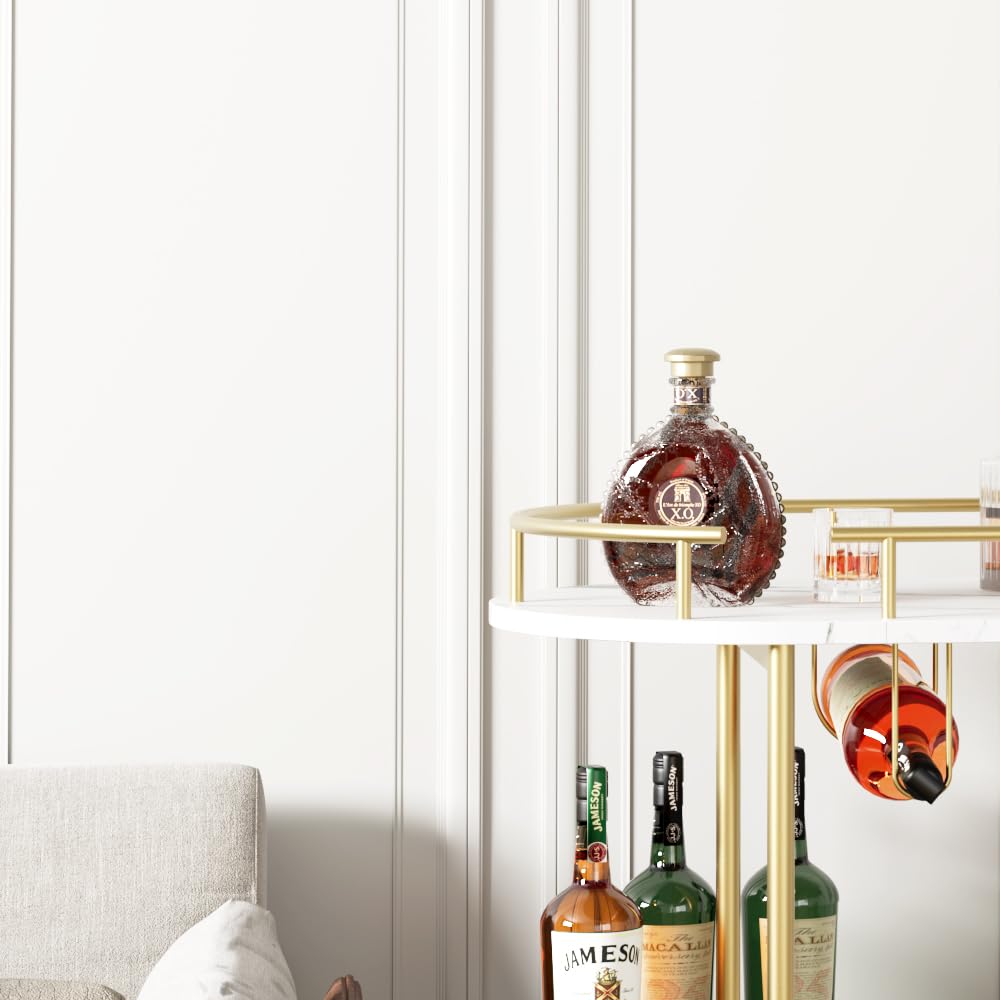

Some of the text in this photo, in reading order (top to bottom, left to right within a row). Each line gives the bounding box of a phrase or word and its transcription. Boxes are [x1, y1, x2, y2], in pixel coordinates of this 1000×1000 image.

[590, 781, 603, 832] JAMESON
[668, 765, 678, 812] JAMESON
[564, 943, 640, 972] JAMESON
